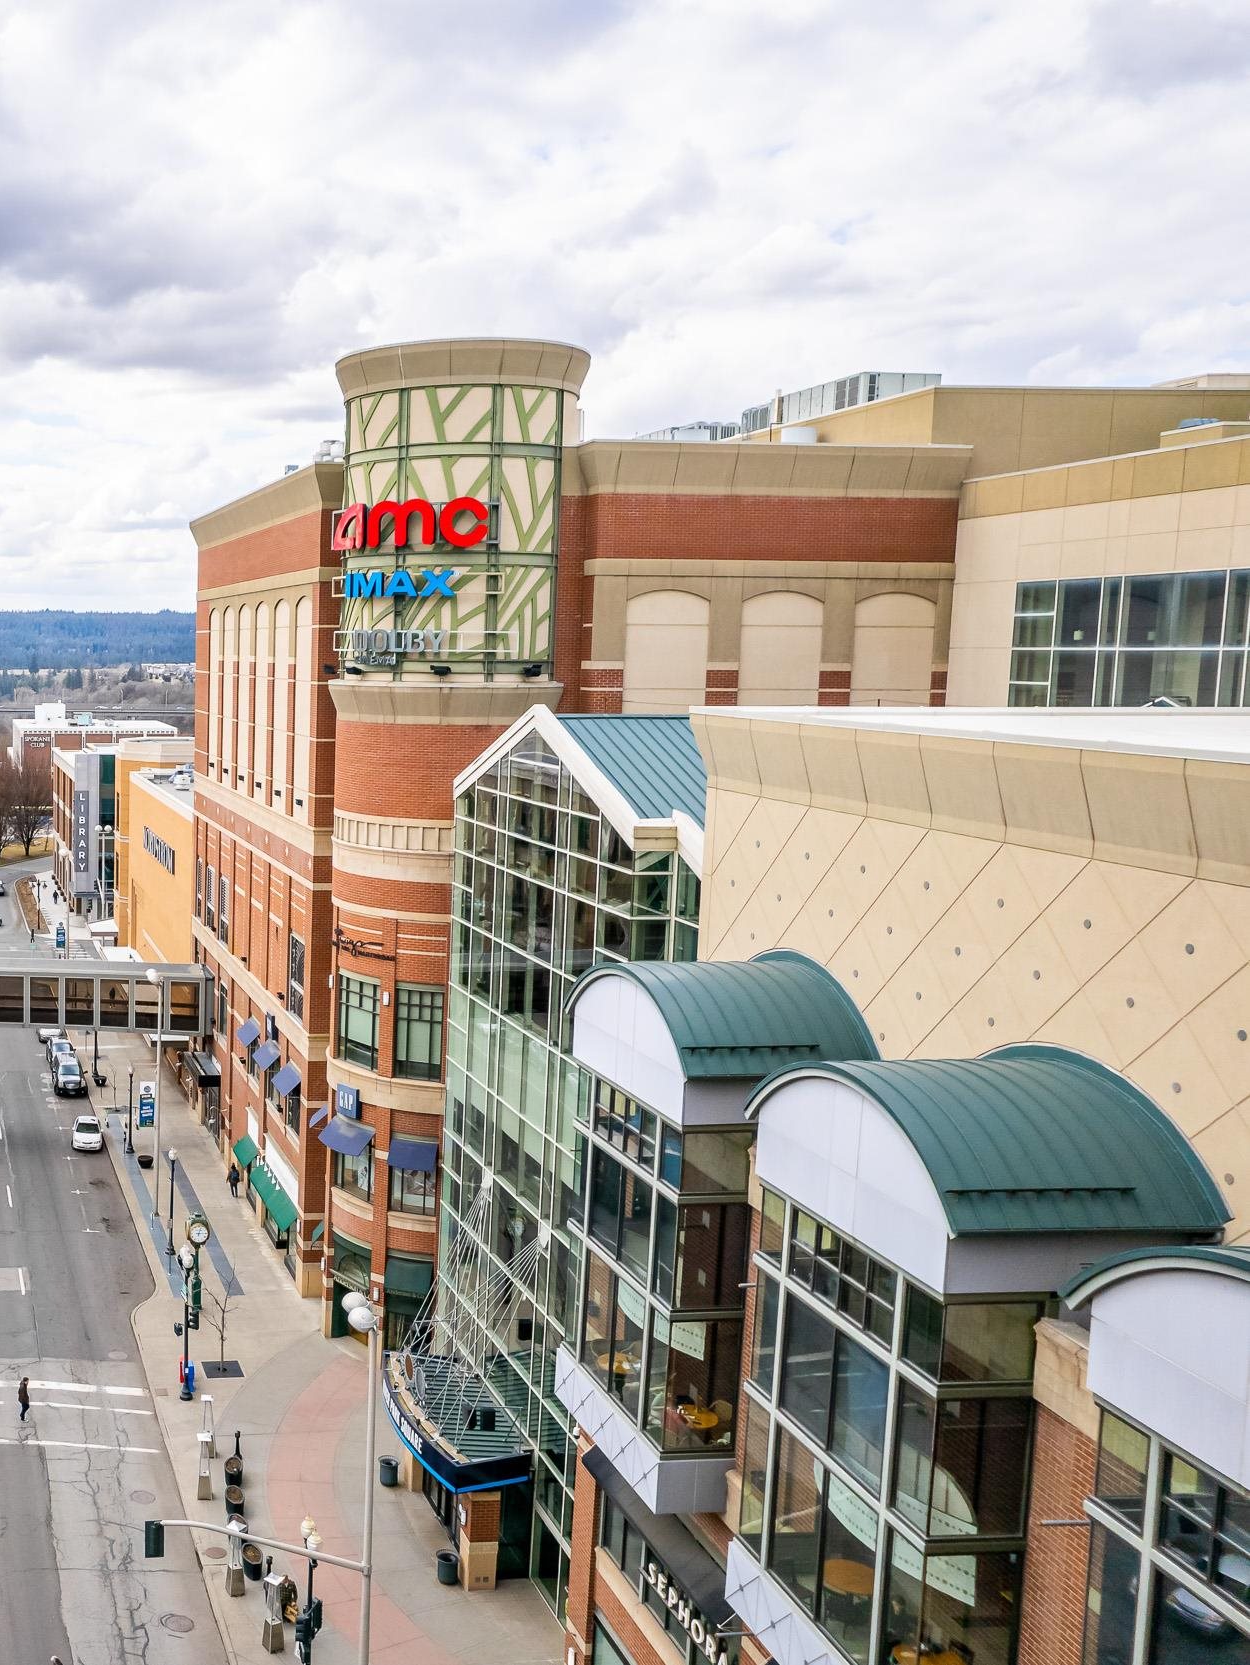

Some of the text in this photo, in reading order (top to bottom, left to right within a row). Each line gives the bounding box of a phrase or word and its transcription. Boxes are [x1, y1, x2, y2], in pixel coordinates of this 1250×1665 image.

[345, 570, 456, 598] IMAX
[353, 629, 448, 653] DOLBY
[78, 792, 87, 871] LIBRARY
[339, 1090, 354, 1111] GAP
[400, 1416, 423, 1455] SQUARE
